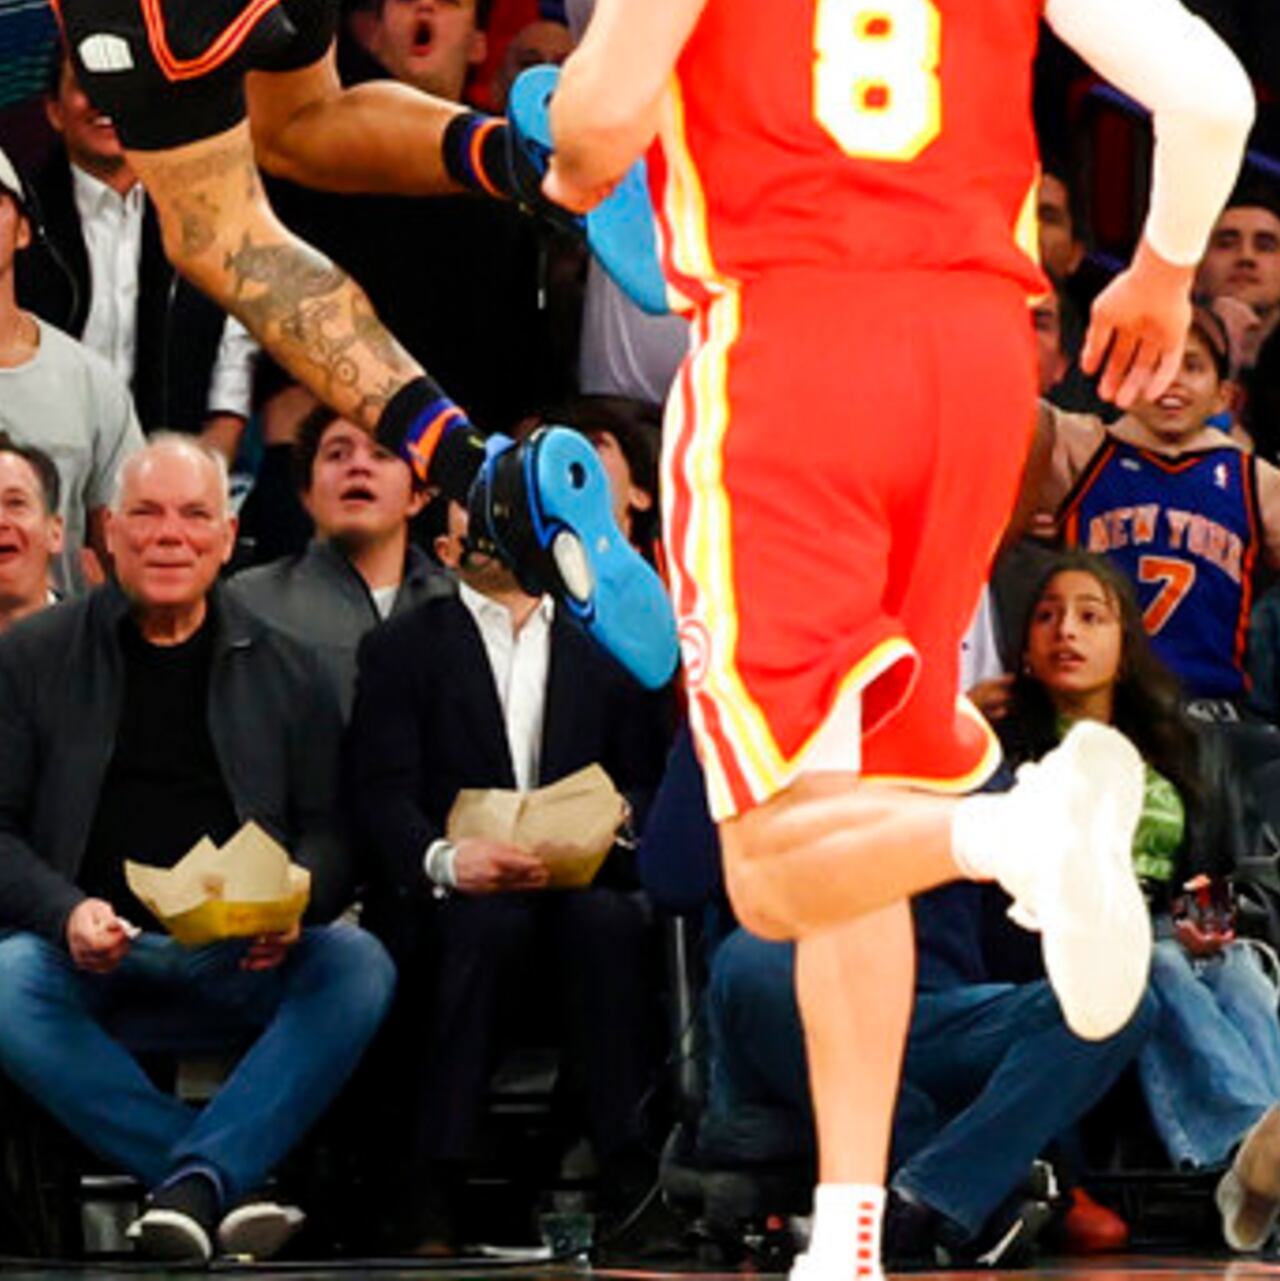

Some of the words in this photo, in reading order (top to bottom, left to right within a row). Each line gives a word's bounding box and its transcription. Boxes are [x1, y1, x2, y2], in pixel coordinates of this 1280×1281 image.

[1087, 503, 1160, 554] NEW
[1166, 507, 1244, 584] YORK
[1138, 555, 1196, 636] 7
